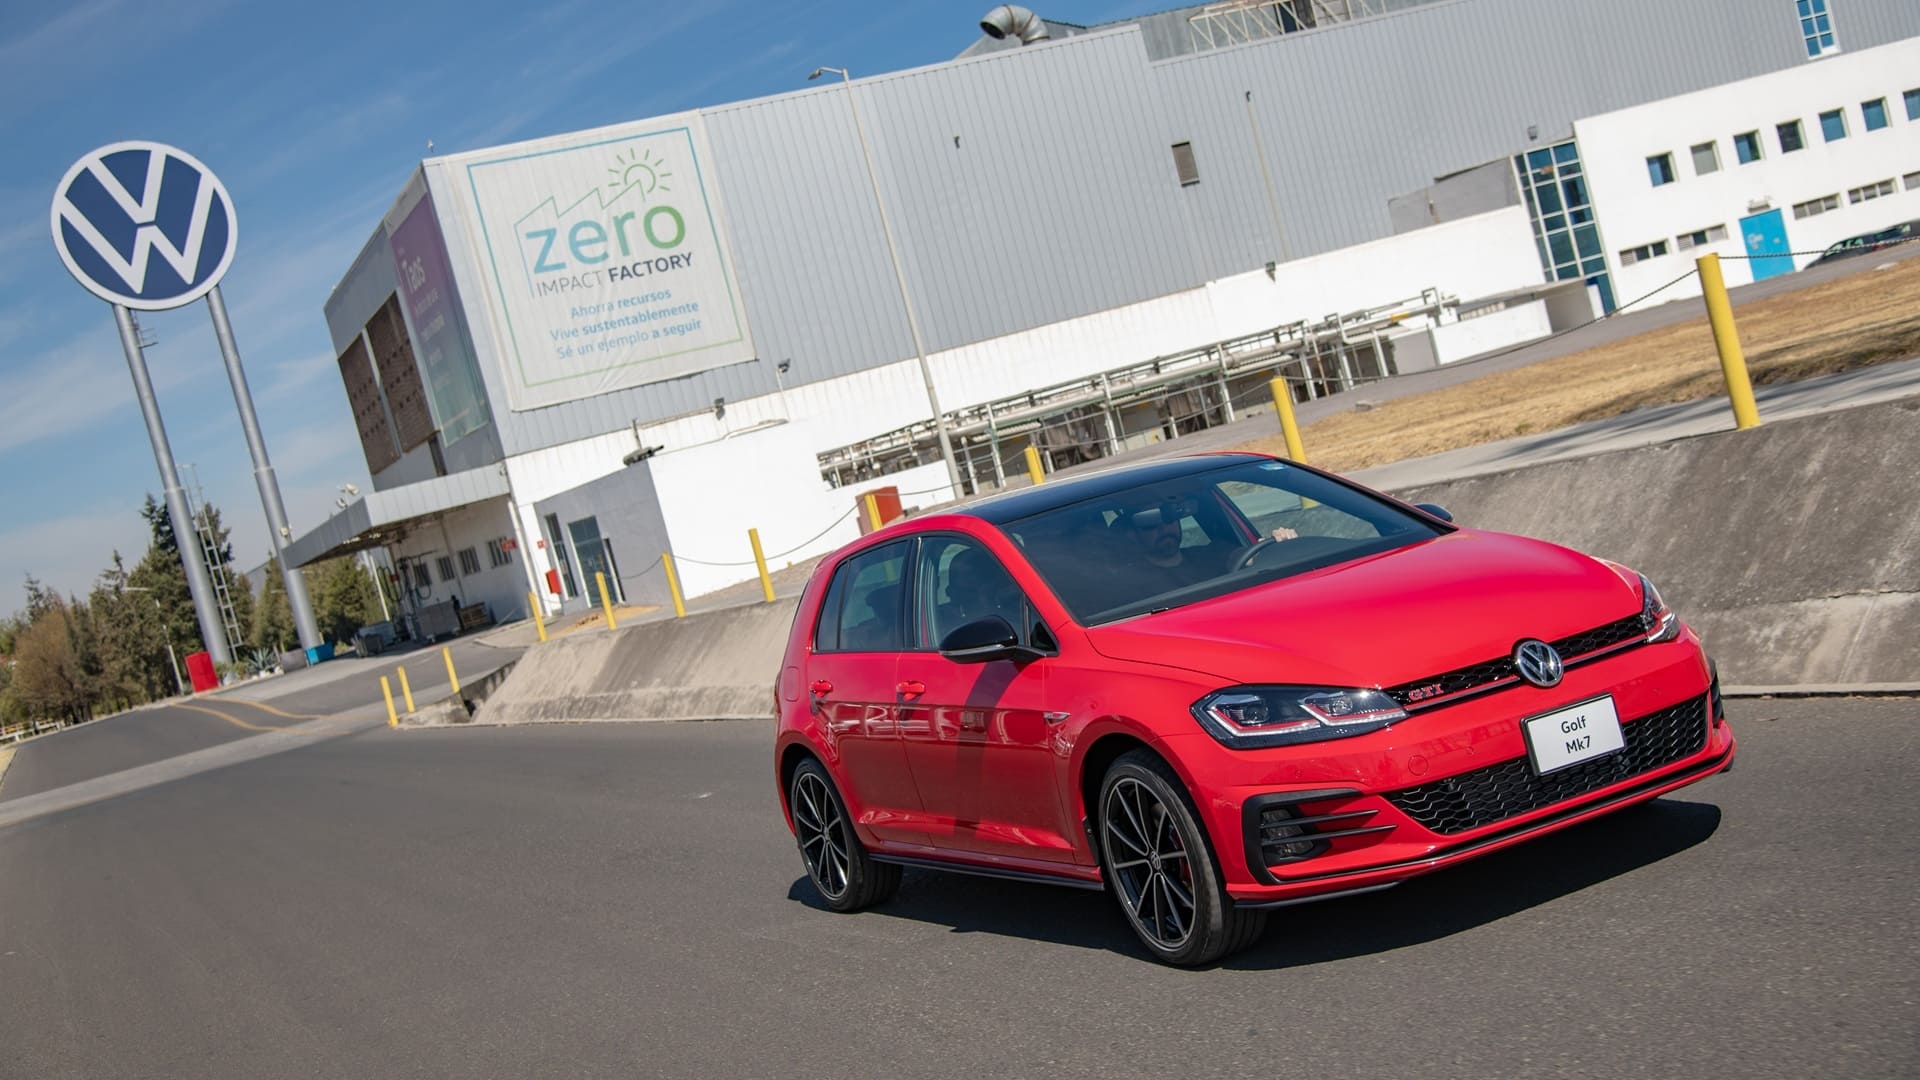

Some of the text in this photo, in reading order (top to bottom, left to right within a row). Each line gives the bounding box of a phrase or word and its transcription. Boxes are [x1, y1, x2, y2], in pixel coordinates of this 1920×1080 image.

[525, 205, 686, 275] zero
[536, 252, 692, 297] IMPACT FACTORY
[571, 289, 672, 318] Ahorra recursos
[550, 302, 699, 341] Vive sustentablemente
[557, 319, 702, 359] Sé un ejemplo a seguir
[1409, 683, 1444, 701] GTI
[1561, 715, 1587, 734] Golf
[1565, 735, 1591, 754] Mk7
